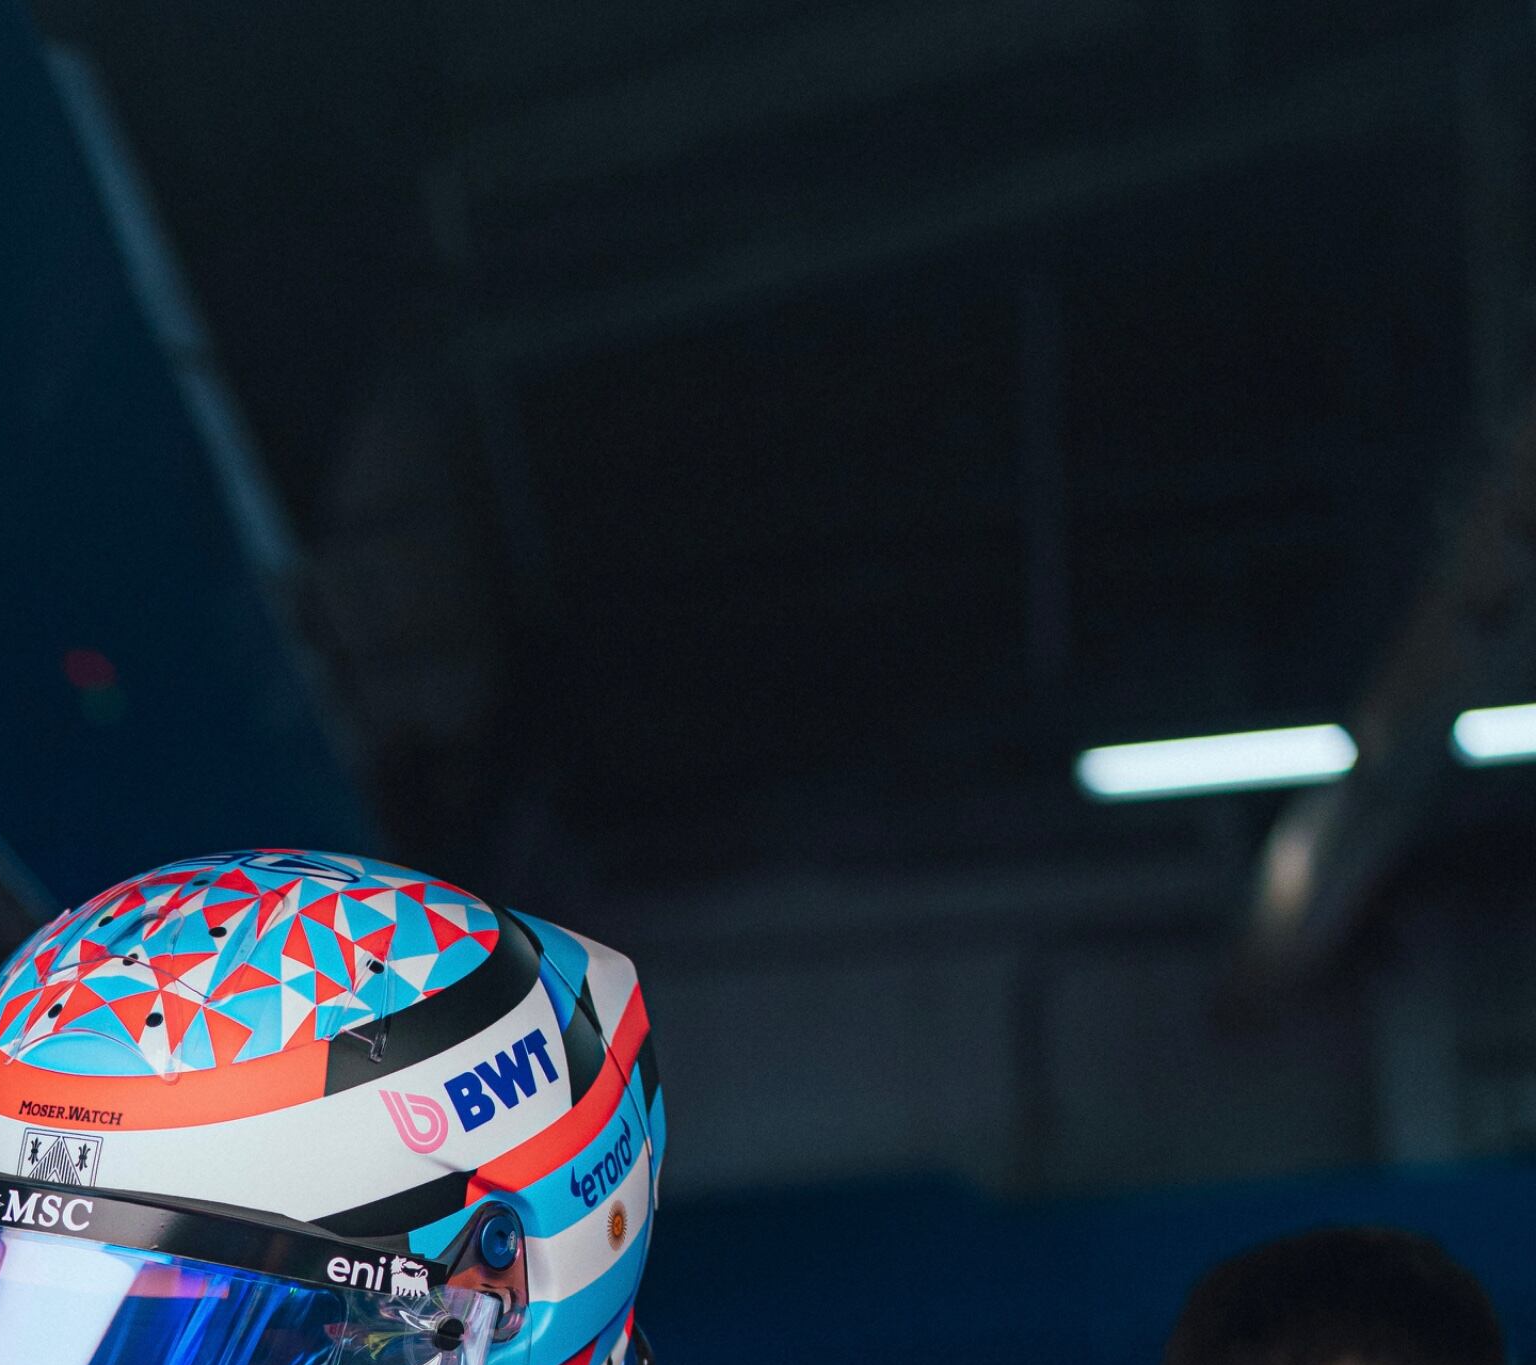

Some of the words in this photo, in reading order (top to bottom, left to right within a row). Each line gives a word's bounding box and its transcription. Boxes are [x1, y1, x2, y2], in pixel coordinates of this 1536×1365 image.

[444, 1028, 559, 1132] BWT
[2, 1189, 93, 1231] MSC
[327, 1256, 386, 1291] eni
